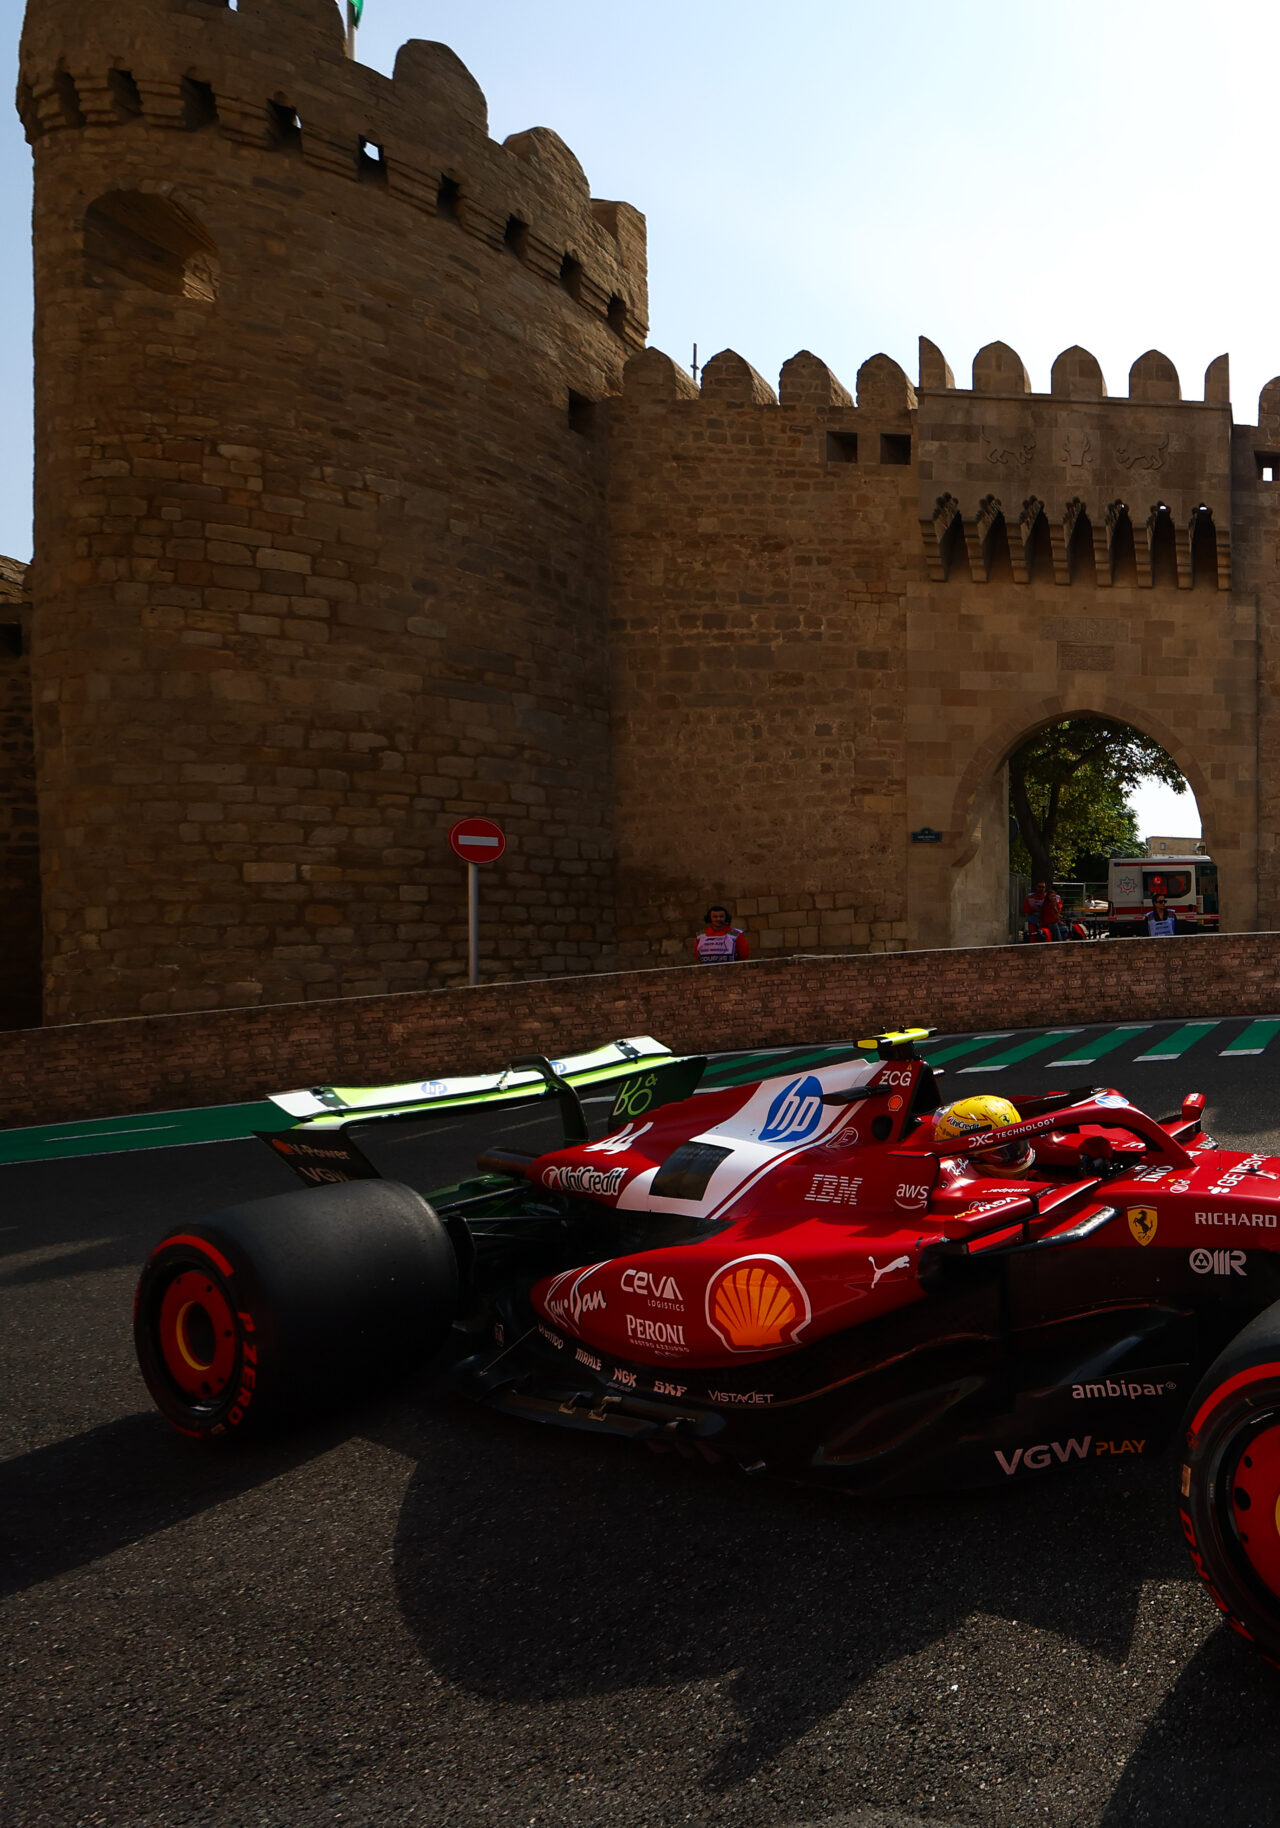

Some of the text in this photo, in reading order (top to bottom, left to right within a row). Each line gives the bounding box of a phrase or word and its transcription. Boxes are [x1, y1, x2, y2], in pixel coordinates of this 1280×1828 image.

[879, 1070, 912, 1087] ZCG
[766, 1076, 822, 1141] hp
[582, 1121, 653, 1155] 44
[996, 1117, 1055, 1139] TECHNOLOGY
[557, 1165, 624, 1196] UniCredit
[804, 1174, 863, 1206] IBM
[896, 1183, 930, 1200] aws
[1194, 1211, 1278, 1229] RICHARD
[647, 1299, 685, 1312] LOGISTICS
[626, 1314, 686, 1346] PERONI
[574, 1348, 602, 1371] MAHLE
[613, 1368, 637, 1388] NGK
[653, 1380, 688, 1398] SKF
[994, 1435, 1146, 1476] VGW PLAY
